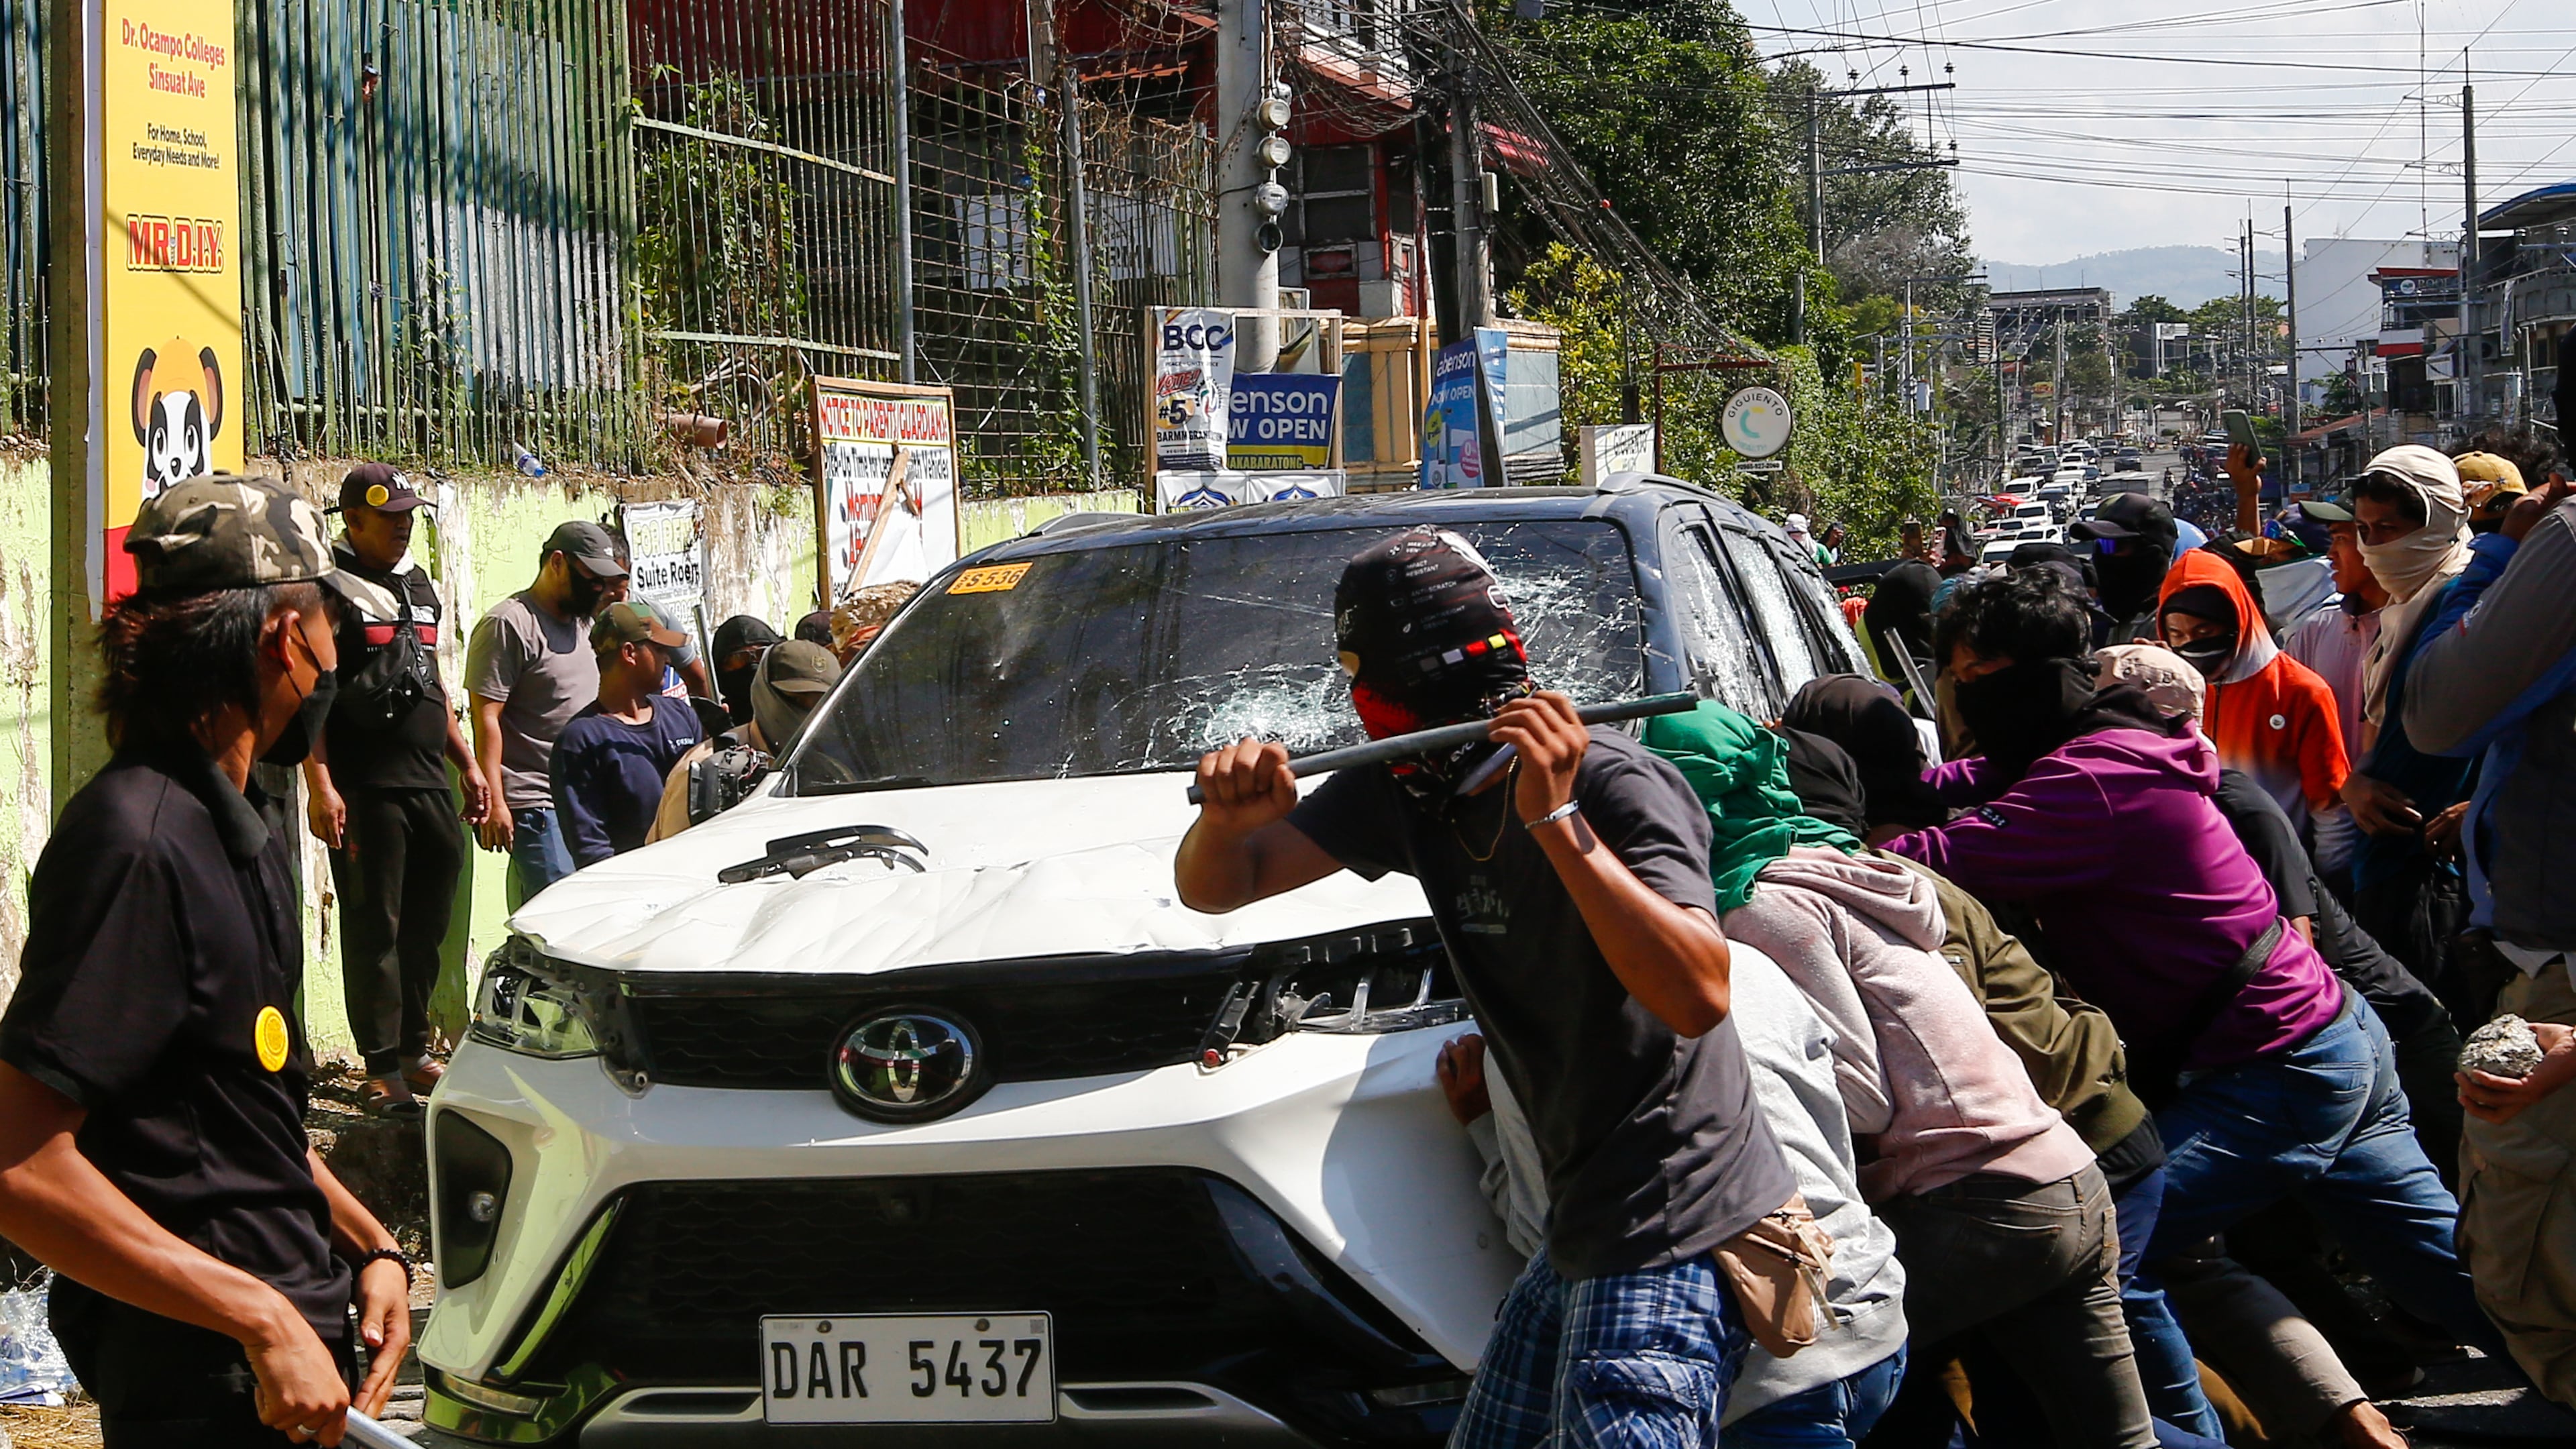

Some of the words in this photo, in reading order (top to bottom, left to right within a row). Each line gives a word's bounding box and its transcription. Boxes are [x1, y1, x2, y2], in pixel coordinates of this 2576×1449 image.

[122, 18, 137, 47] Dr.
[140, 23, 182, 62] Ocampo
[184, 33, 225, 70] Colleges
[149, 62, 186, 96] Sinsuat
[188, 71, 205, 98] Ave
[148, 123, 159, 141] For
[160, 124, 182, 146] Home,
[183, 129, 207, 149] School,
[133, 142, 165, 167] Everyday
[166, 146, 186, 166] Needs
[188, 149, 200, 167] and
[201, 150, 219, 170] More!
[1436, 350, 1475, 377] abenson
[1157, 369, 1201, 394] VOTE!
[1450, 384, 1475, 400] OPEN
[1159, 400, 1187, 424] #5
[1230, 391, 1328, 415] enson
[1728, 393, 1783, 419] GIGUIENTO
[819, 397, 851, 437] NOTICE
[851, 398, 862, 437] TO
[1258, 418, 1326, 440] OPEN
[1157, 431, 1187, 442] BARMM
[851, 447, 869, 478] Time
[922, 449, 949, 480] Vehicles
[845, 481, 882, 522] Mornin
[631, 520, 661, 559] FOR
[637, 561, 668, 588] Suite
[771, 1342, 869, 1399] DAR
[908, 1339, 1042, 1399] 5437
